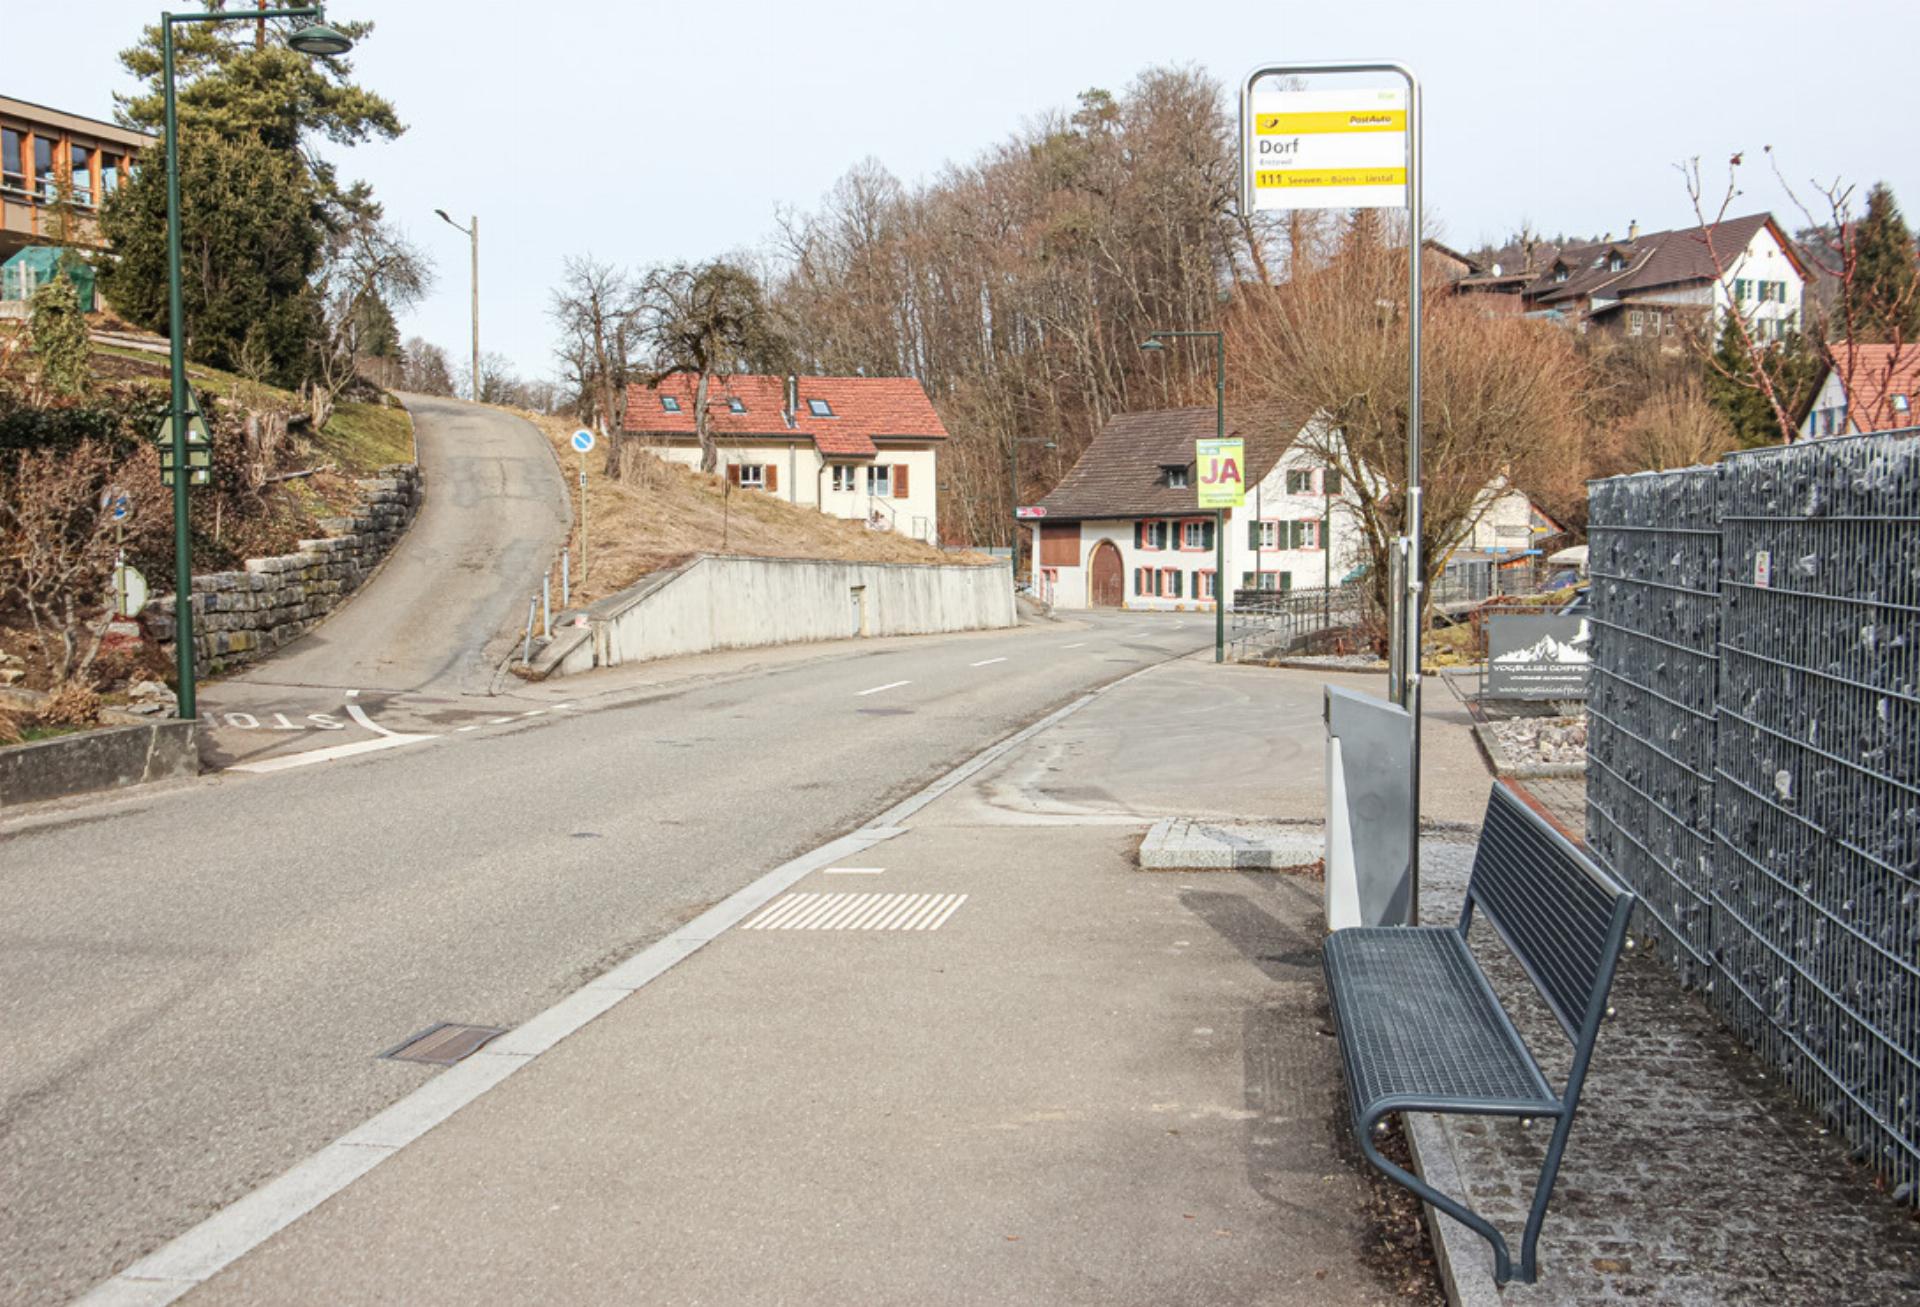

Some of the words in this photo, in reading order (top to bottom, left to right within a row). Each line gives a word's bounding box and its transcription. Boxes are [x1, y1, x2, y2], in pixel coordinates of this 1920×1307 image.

[1349, 115, 1391, 124] PostAuto
[1259, 138, 1299, 154] Dorf
[1261, 173, 1282, 184] 111
[1200, 458, 1241, 484] JA
